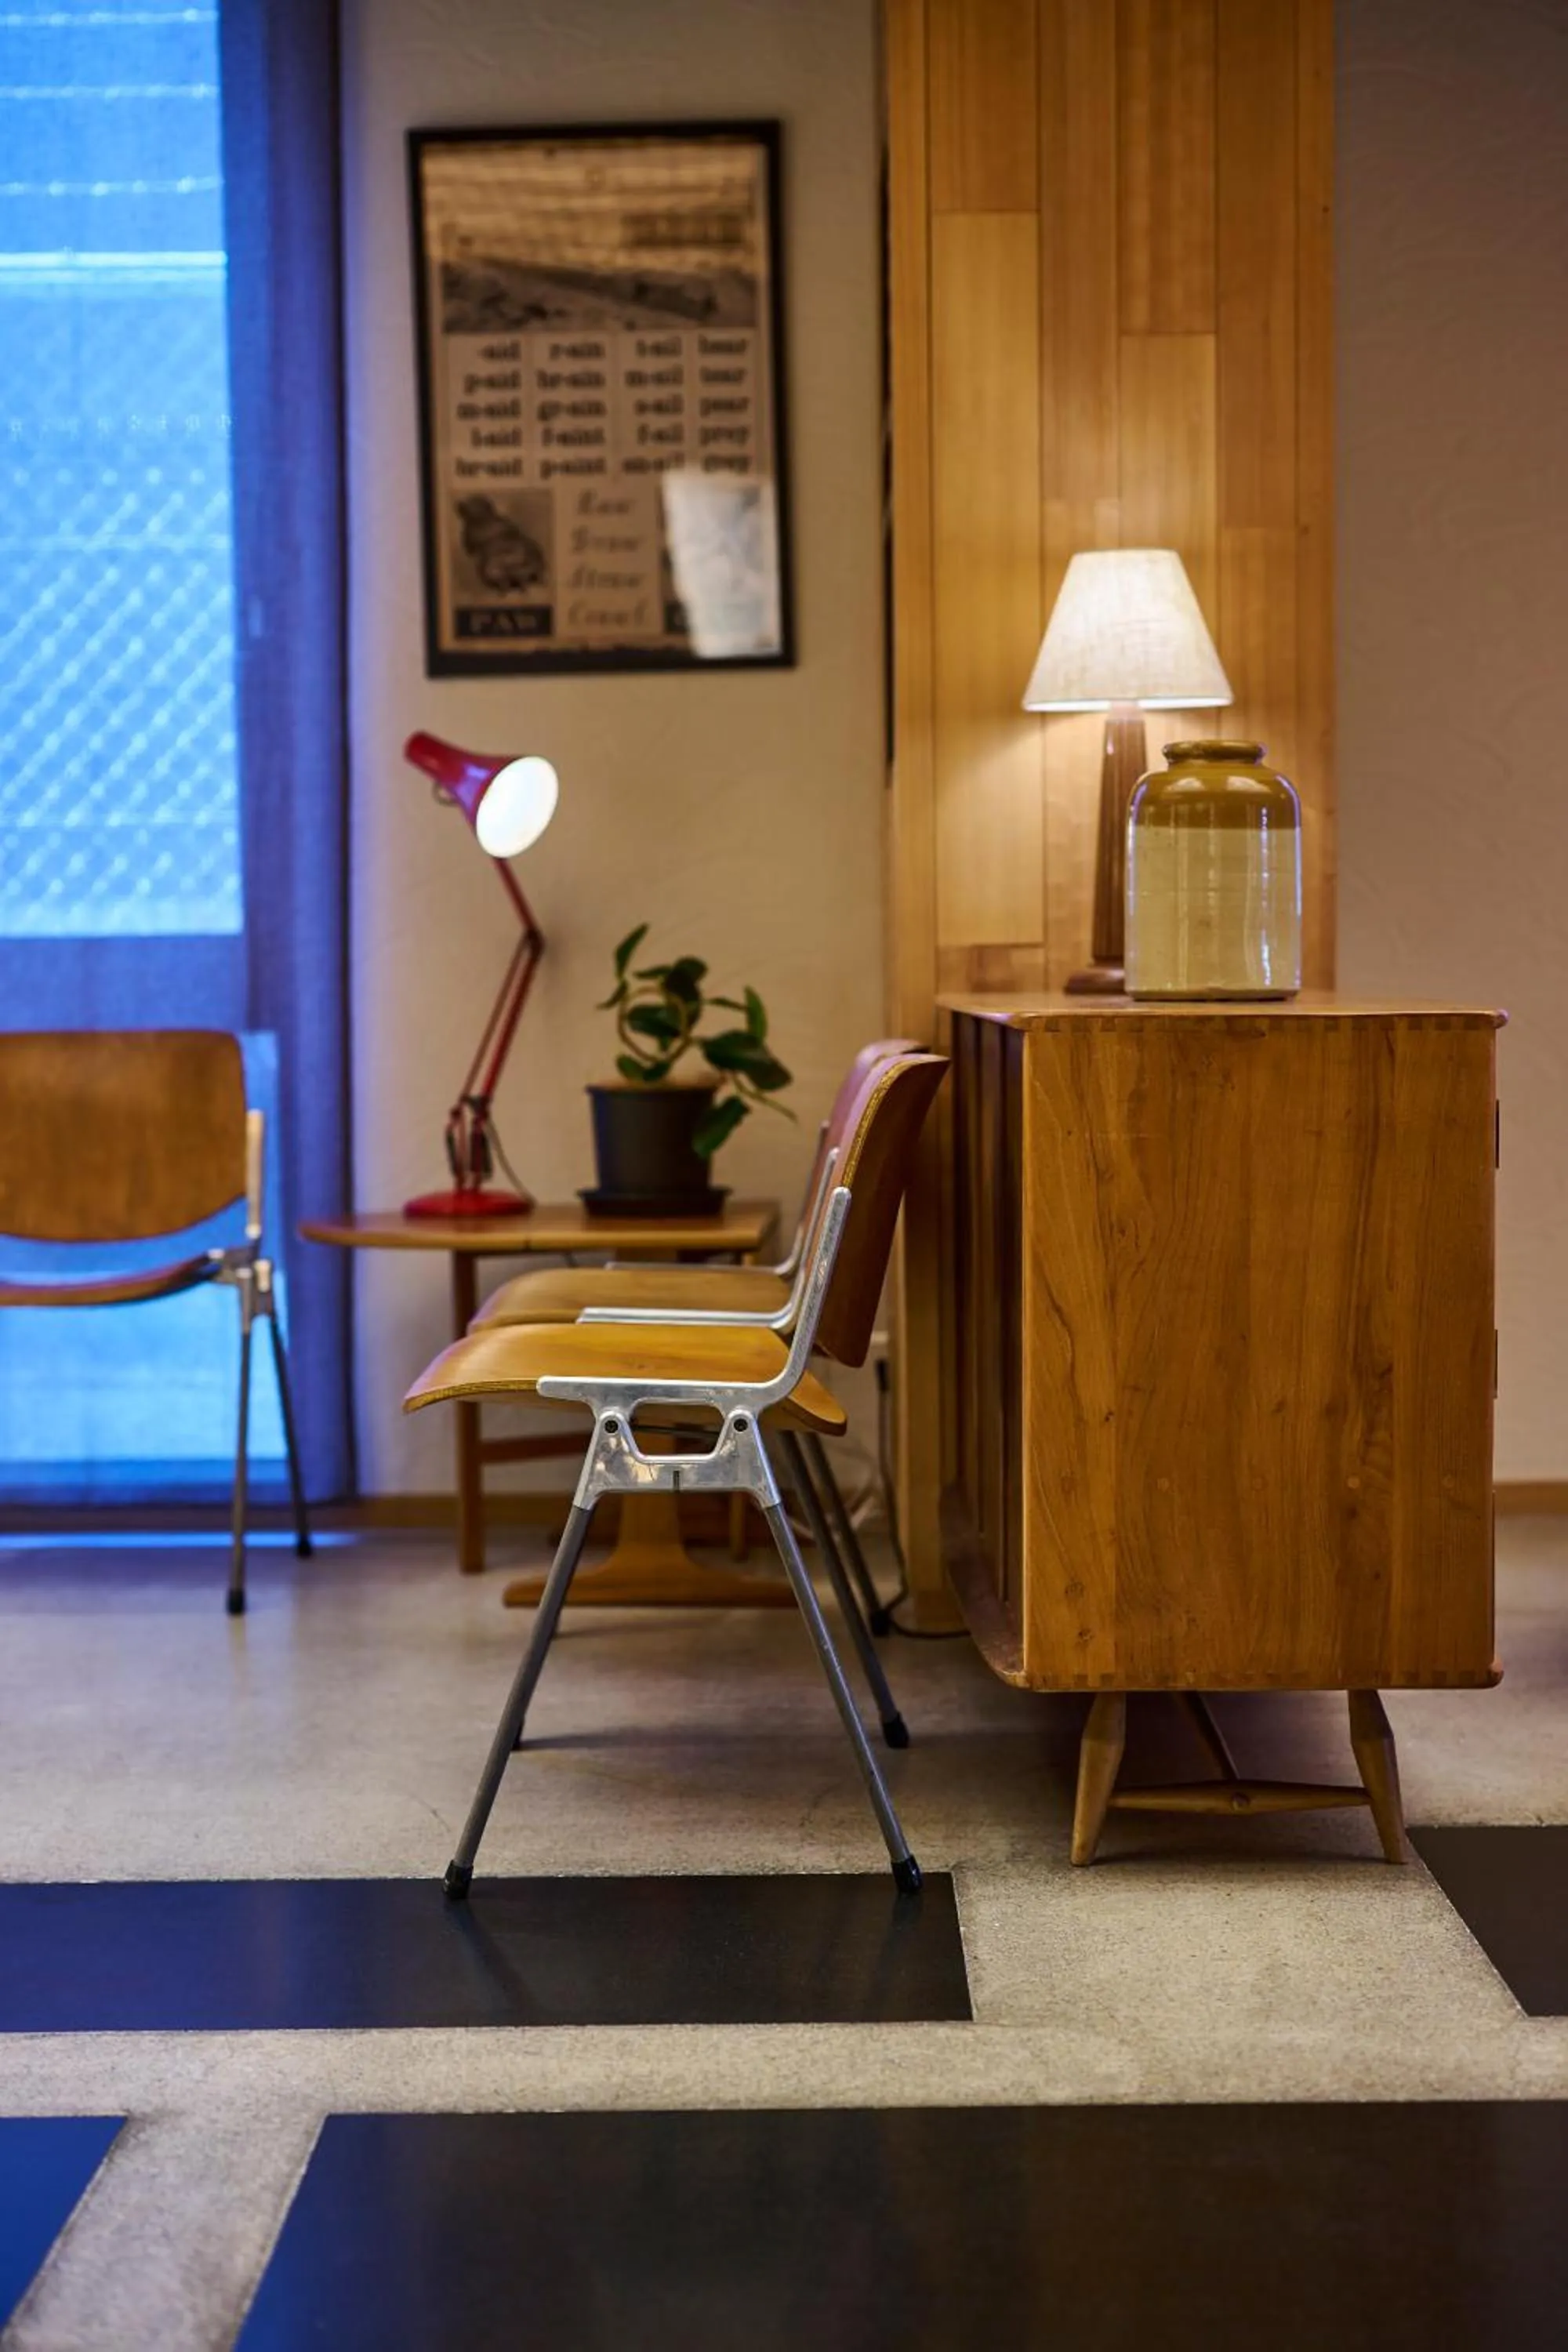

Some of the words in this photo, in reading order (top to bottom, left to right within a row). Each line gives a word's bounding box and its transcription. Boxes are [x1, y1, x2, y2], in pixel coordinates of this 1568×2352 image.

[464, 370, 521, 395] p-aid
[536, 370, 606, 389] br-ain
[625, 365, 683, 386] m-ail
[457, 398, 521, 419] m-aid
[538, 400, 607, 422] gr-ain
[456, 459, 523, 477] br-aid
[540, 459, 607, 480] p-aint
